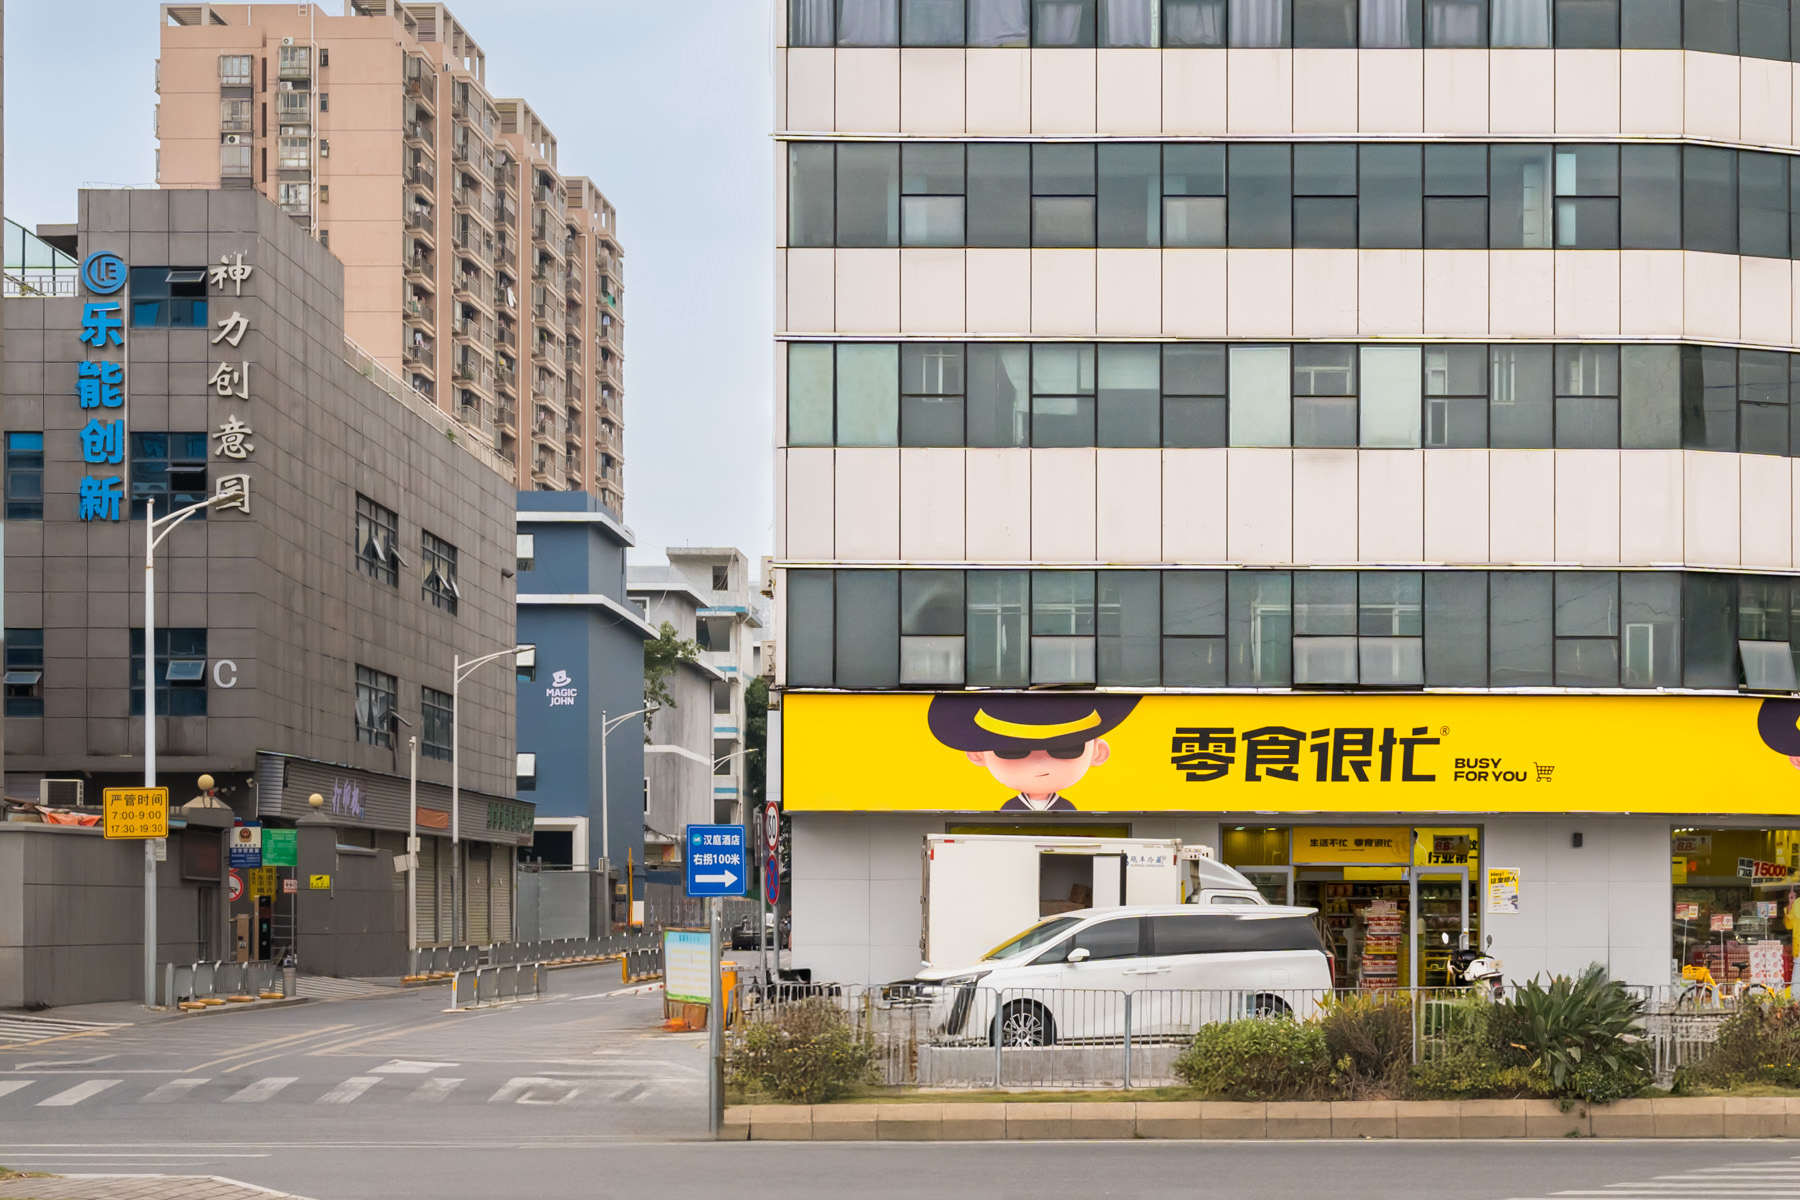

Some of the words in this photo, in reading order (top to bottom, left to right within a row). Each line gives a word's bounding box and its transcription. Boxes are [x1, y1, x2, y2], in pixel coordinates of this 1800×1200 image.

[208, 253, 255, 514] 神力创意园
[78, 302, 124, 521] 乐能创新
[213, 660, 237, 688] C
[546, 688, 577, 698] MAGIC
[550, 697, 575, 707] JOHN
[1171, 726, 1441, 782] 零食很忙
[1454, 758, 1502, 769] BUSY
[1454, 771, 1490, 782] FOR
[1492, 771, 1527, 782] YOU
[110, 794, 163, 806] 严管时间
[112, 811, 162, 820] 7:00-9:00
[111, 824, 163, 833] 17:30-19:30
[703, 834, 740, 846] 汉庭酒店
[1310, 838, 1347, 847] 生活不忙
[1354, 838, 1392, 847] 零食很忙
[693, 854, 740, 865] 右拐100米
[1754, 861, 1787, 877] 15000
